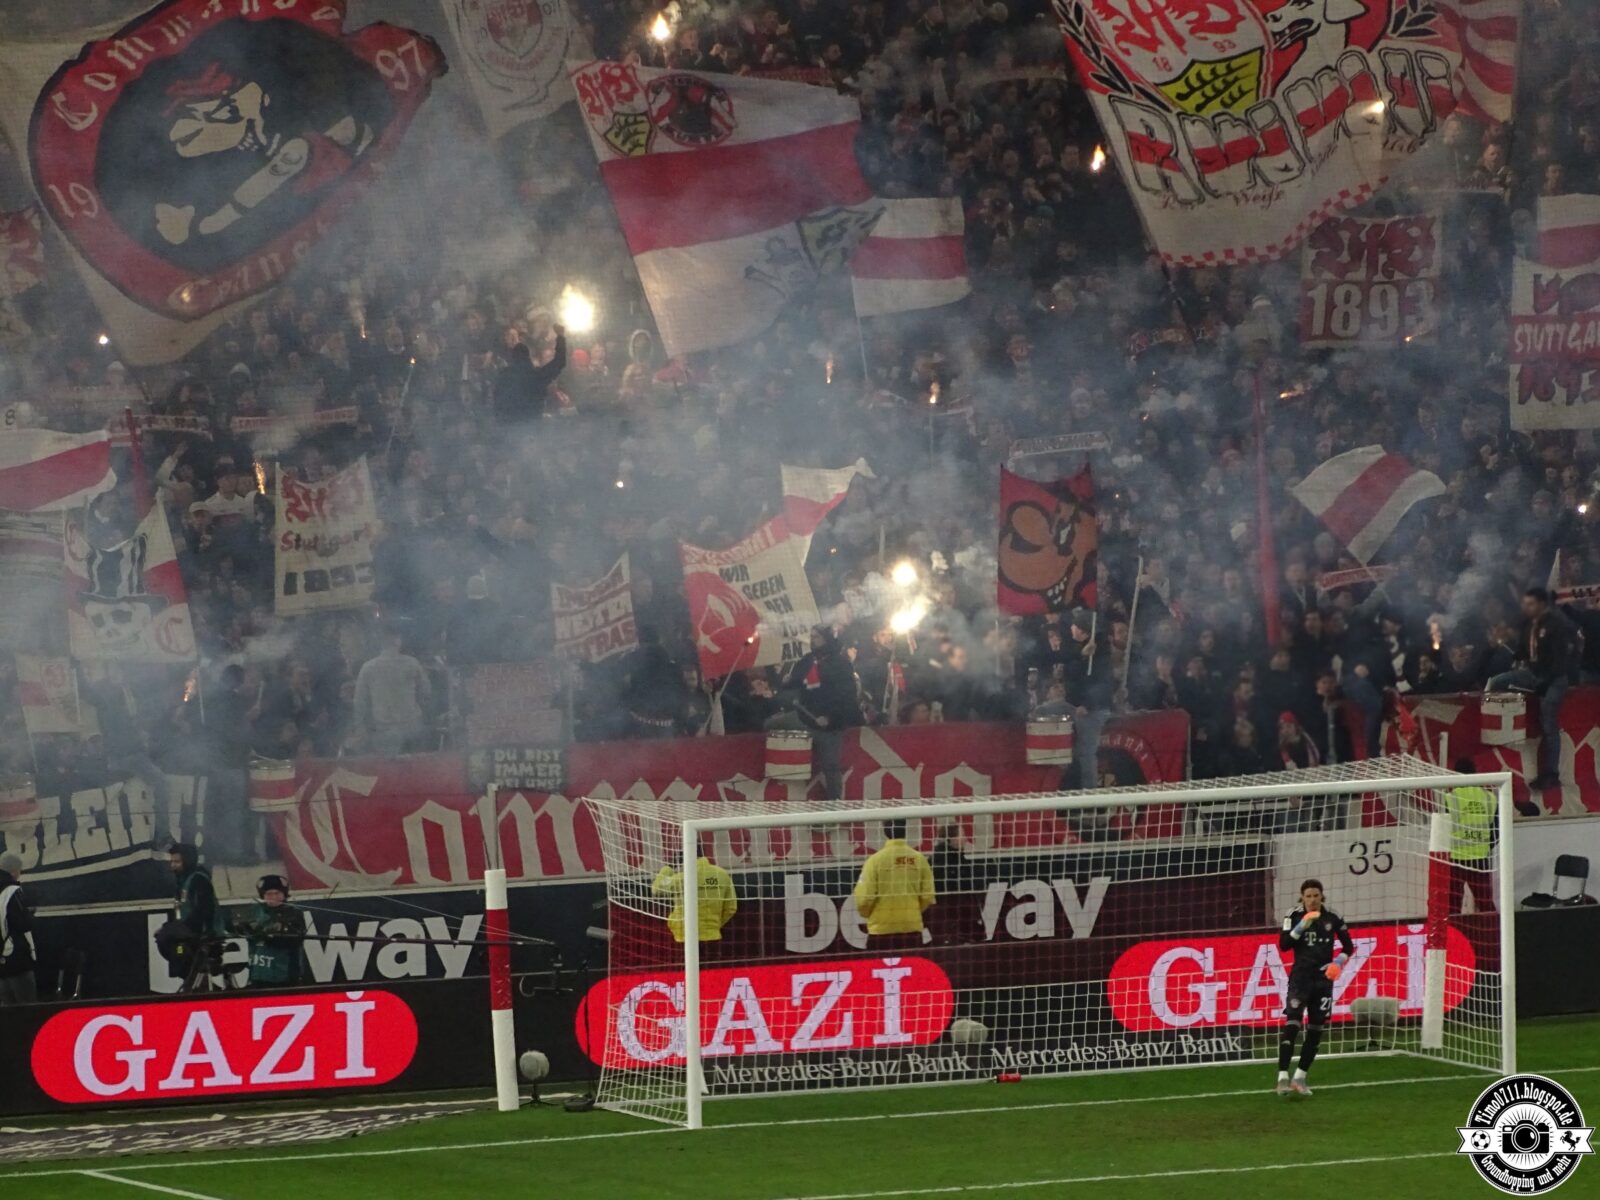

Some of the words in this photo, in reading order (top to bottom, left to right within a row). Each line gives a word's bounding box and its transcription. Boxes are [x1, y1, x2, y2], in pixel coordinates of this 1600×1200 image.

[375, 38, 427, 91] 97
[1151, 56, 1173, 73] 18
[1212, 39, 1237, 53] 93
[49, 182, 99, 218] 19
[1307, 281, 1434, 338] 1893
[1515, 320, 1600, 354] STUTTGA
[719, 562, 750, 583] WIR
[742, 573, 786, 600] GEBEN
[764, 593, 793, 614] DEN
[782, 641, 803, 660] AN
[495, 749, 517, 762] DU
[495, 762, 562, 777] IMMER
[525, 749, 561, 762] BIST
[1348, 839, 1394, 876] 35
[990, 1038, 1176, 1070] Mercedes-Benz
[1180, 1032, 1243, 1058] Bank
[713, 1056, 899, 1086] Mercedes-Benz
[908, 1052, 973, 1075] Bank
